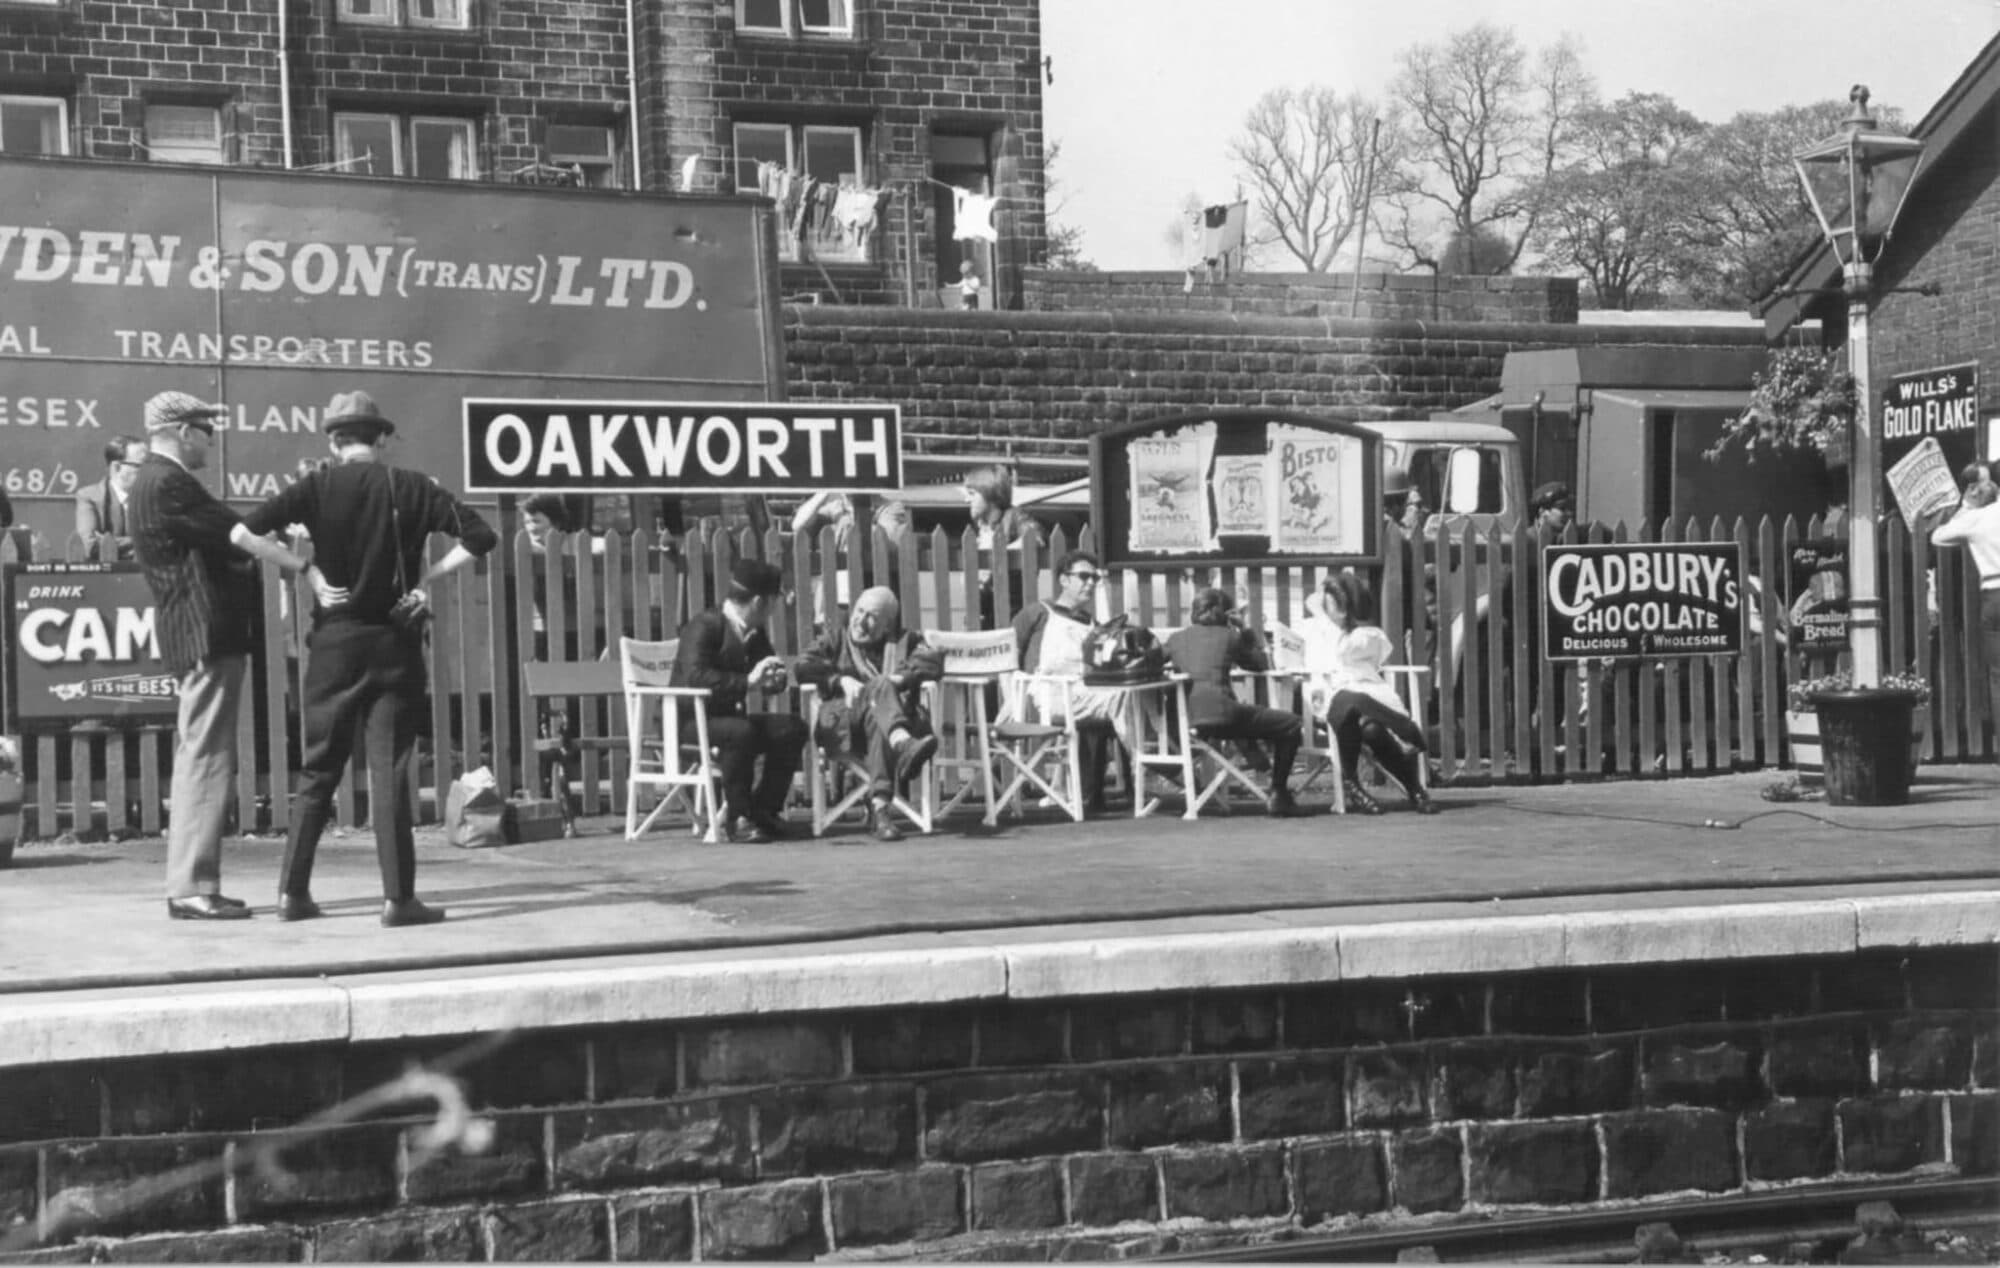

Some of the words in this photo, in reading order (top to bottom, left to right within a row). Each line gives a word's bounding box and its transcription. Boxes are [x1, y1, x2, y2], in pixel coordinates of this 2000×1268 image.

[189, 246, 231, 289] &
[240, 239, 393, 296] SON
[397, 248, 548, 303] (TRANS)
[550, 256, 707, 311] LTD.
[114, 330, 433, 368] TRANSPORTERS
[484, 413, 889, 478] OAKWORTH
[1281, 443, 1338, 481] BISTO
[28, 584, 84, 599] DRINK
[1548, 552, 1738, 616] CADBURY'S
[1573, 602, 1719, 633] CHOCOLATE
[1804, 620, 1845, 641] Bread
[1563, 636, 1629, 651] DELICIOUS
[1653, 634, 1728, 648] WHOLESOME
